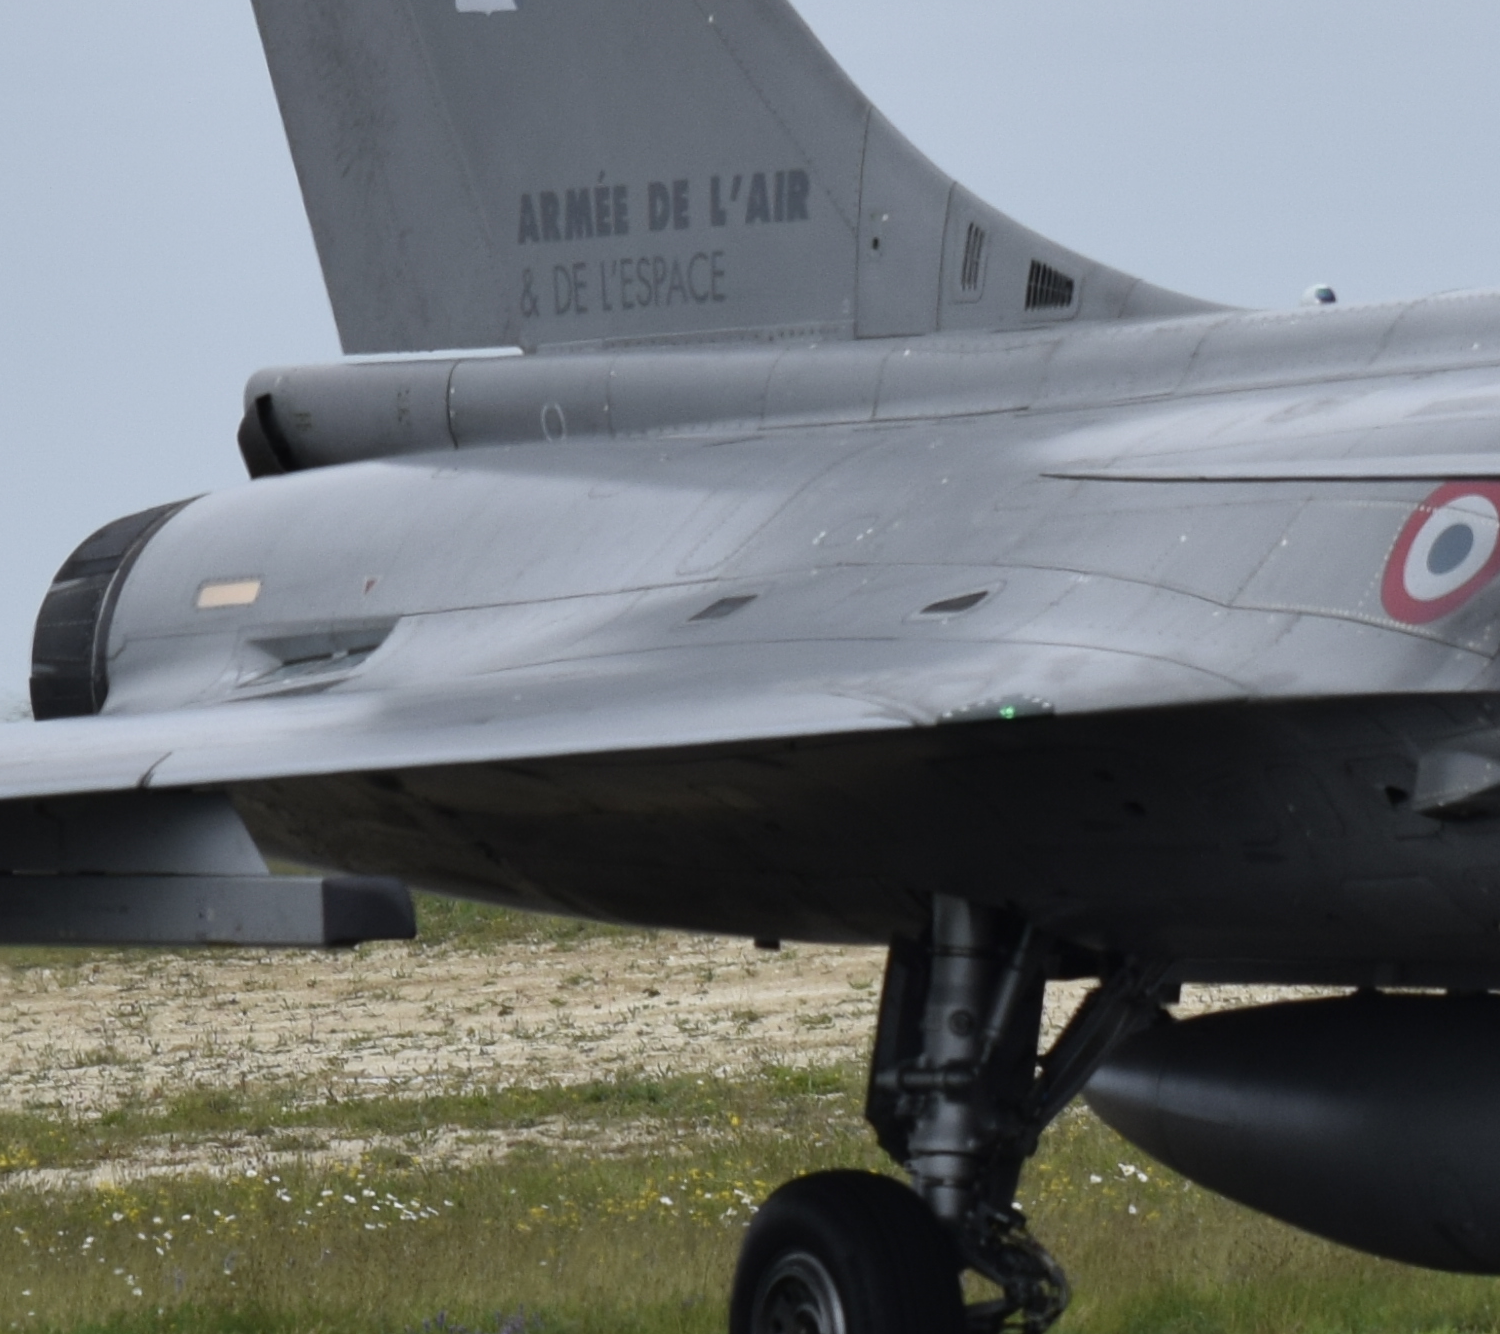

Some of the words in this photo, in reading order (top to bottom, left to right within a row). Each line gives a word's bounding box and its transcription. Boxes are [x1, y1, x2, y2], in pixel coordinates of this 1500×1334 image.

[517, 169, 629, 245] ARMÉE
[647, 178, 691, 233] DE
[709, 169, 811, 227] L'AIR
[520, 267, 541, 318] &
[553, 261, 589, 316] DE
[601, 250, 728, 312] L'ESPACE
